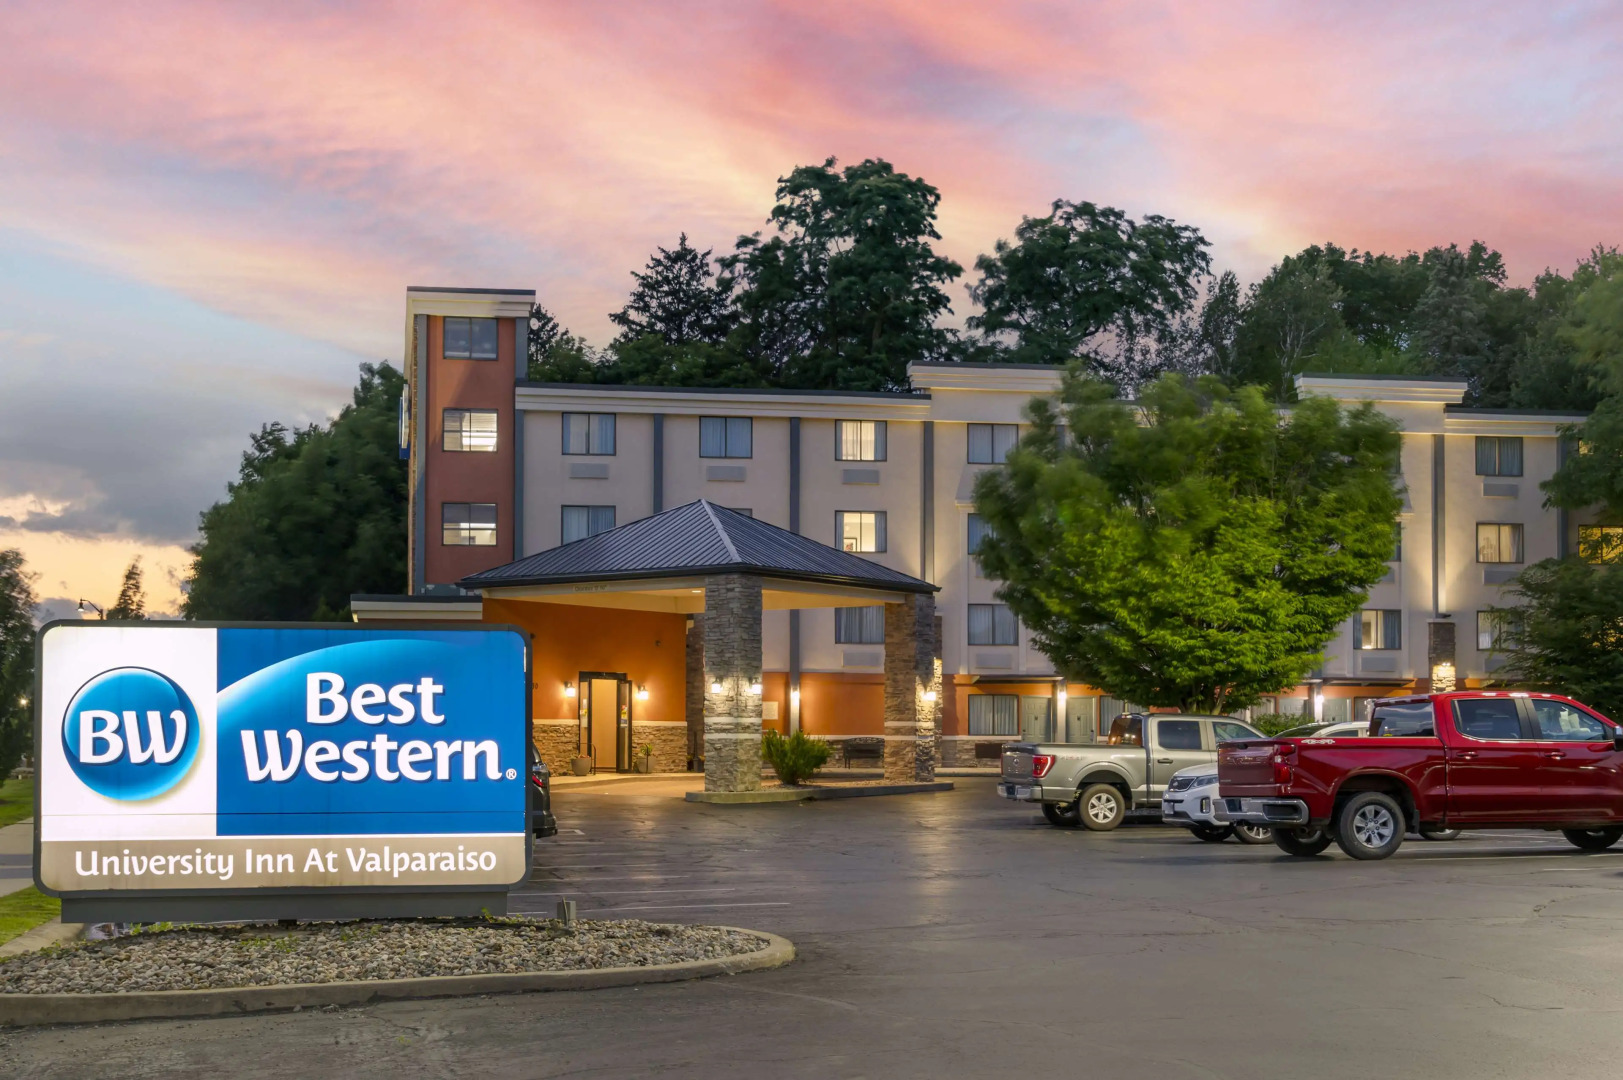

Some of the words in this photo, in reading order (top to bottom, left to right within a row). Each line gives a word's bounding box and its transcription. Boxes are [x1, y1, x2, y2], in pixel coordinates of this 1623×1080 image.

[306, 672, 445, 724] Best
[79, 709, 187, 764] BW
[75, 847, 234, 881] University
[245, 848, 295, 874] Inn
[303, 848, 339, 873] At
[345, 845, 497, 878] Valparaiso
